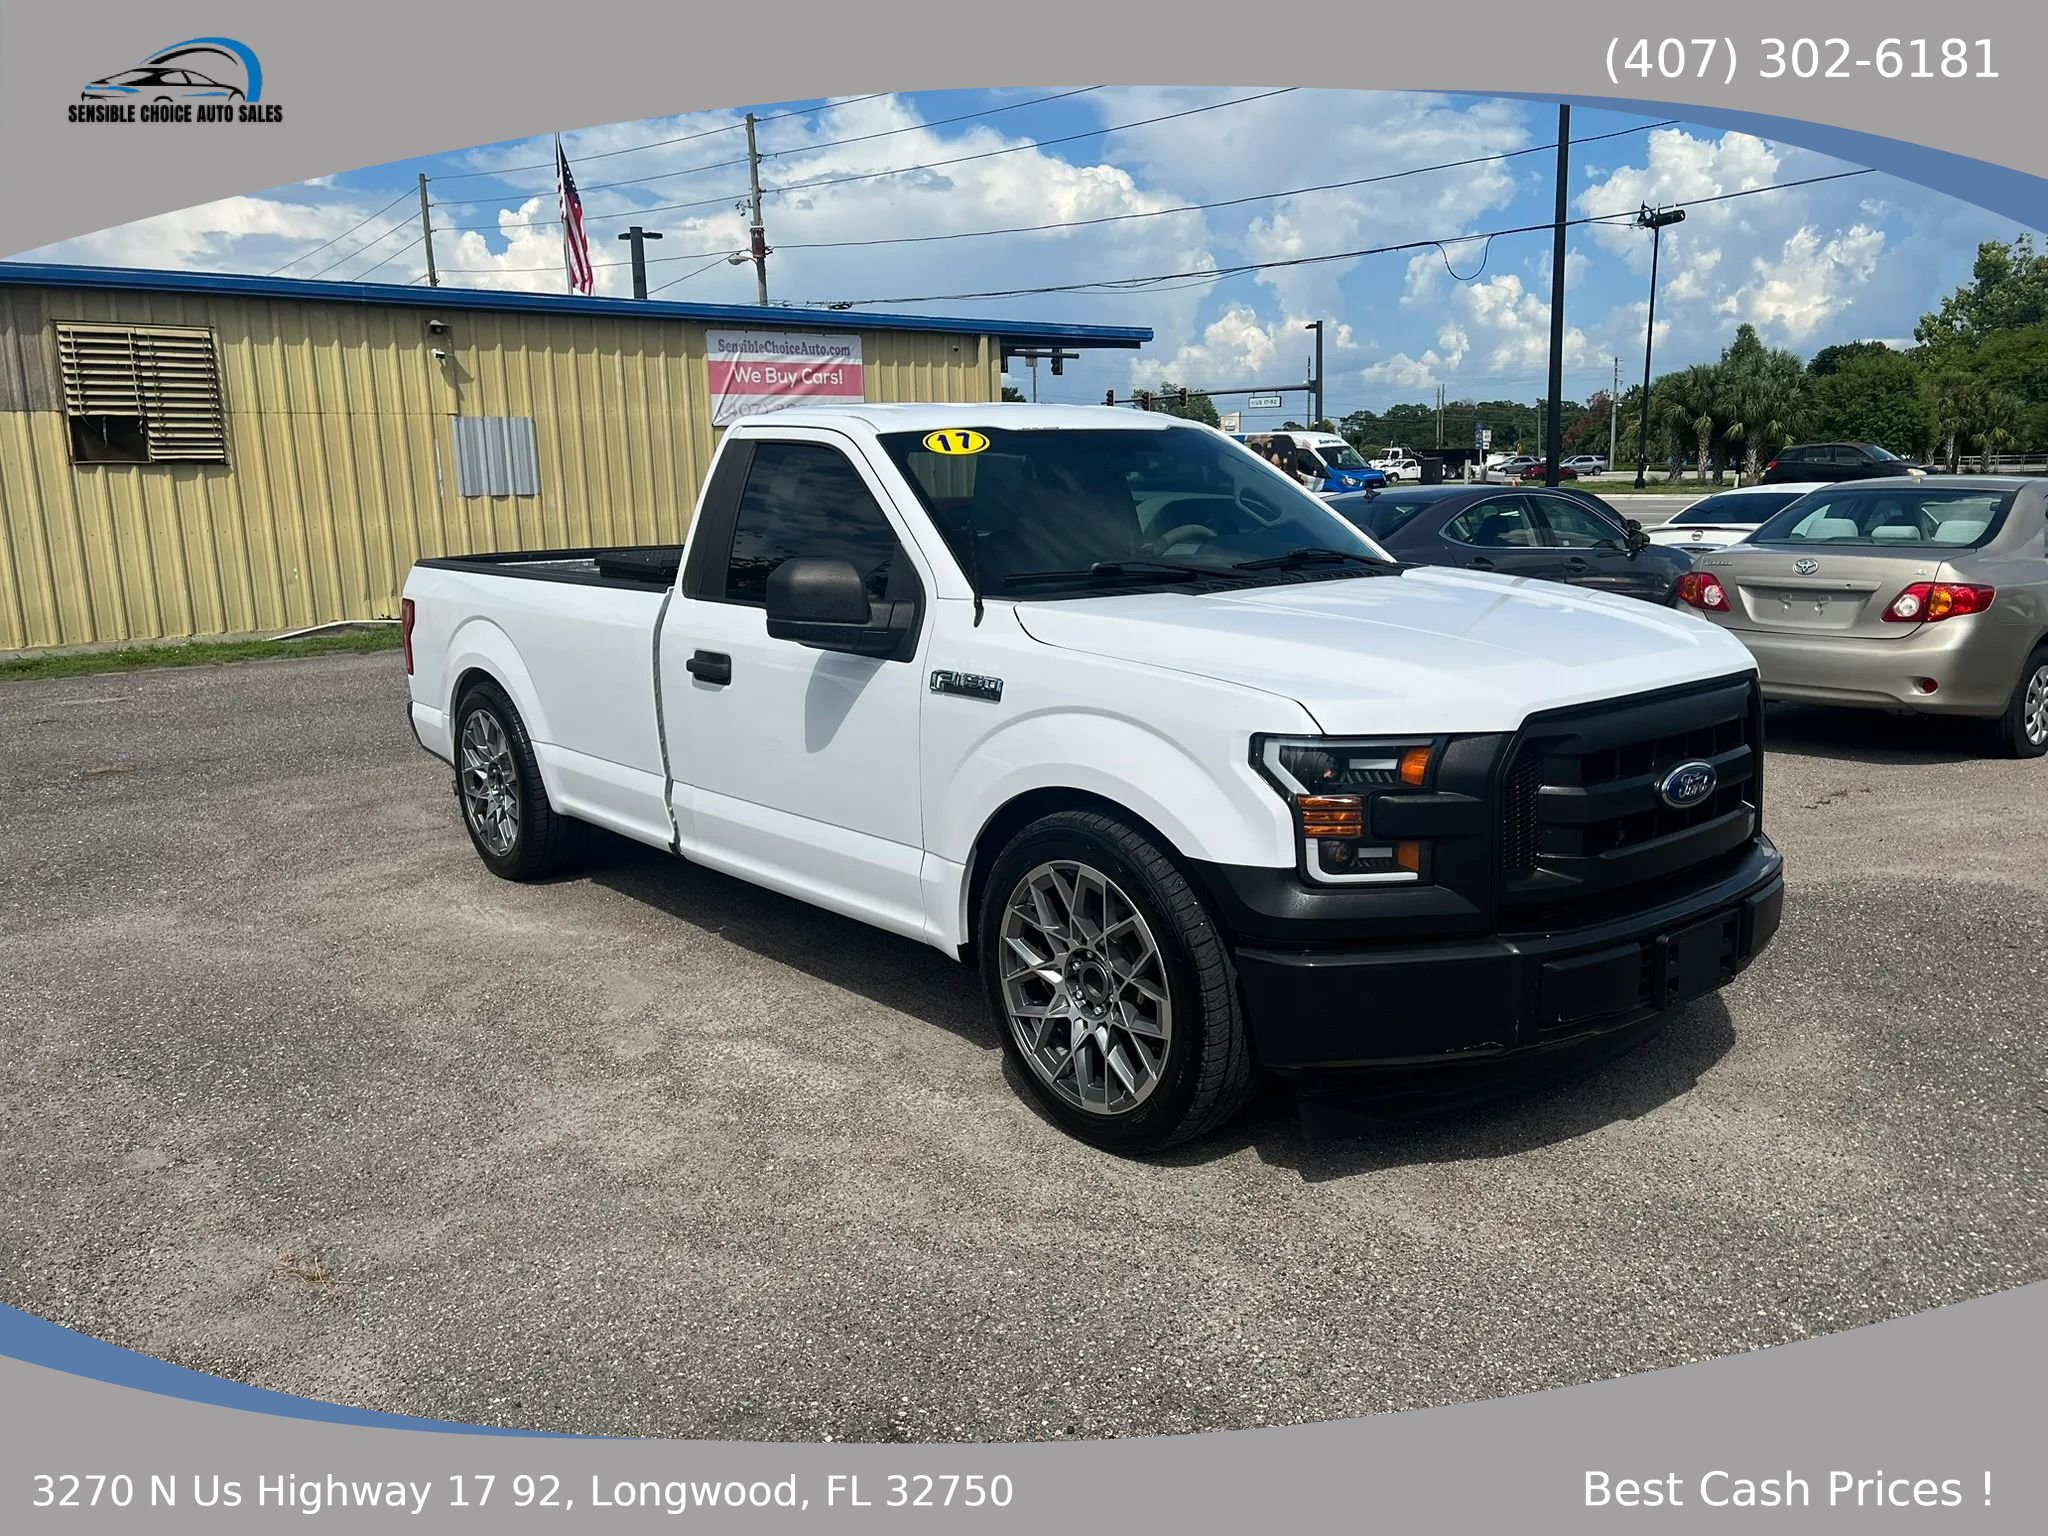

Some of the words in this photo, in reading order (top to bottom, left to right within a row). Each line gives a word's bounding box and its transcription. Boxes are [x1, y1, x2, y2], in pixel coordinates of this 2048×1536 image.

[717, 338, 851, 357] SensibleChoiceAuto.com
[732, 365, 762, 384] We
[765, 367, 798, 388] Buy
[801, 368, 844, 385] Cars!
[1678, 771, 1709, 799] Ford
